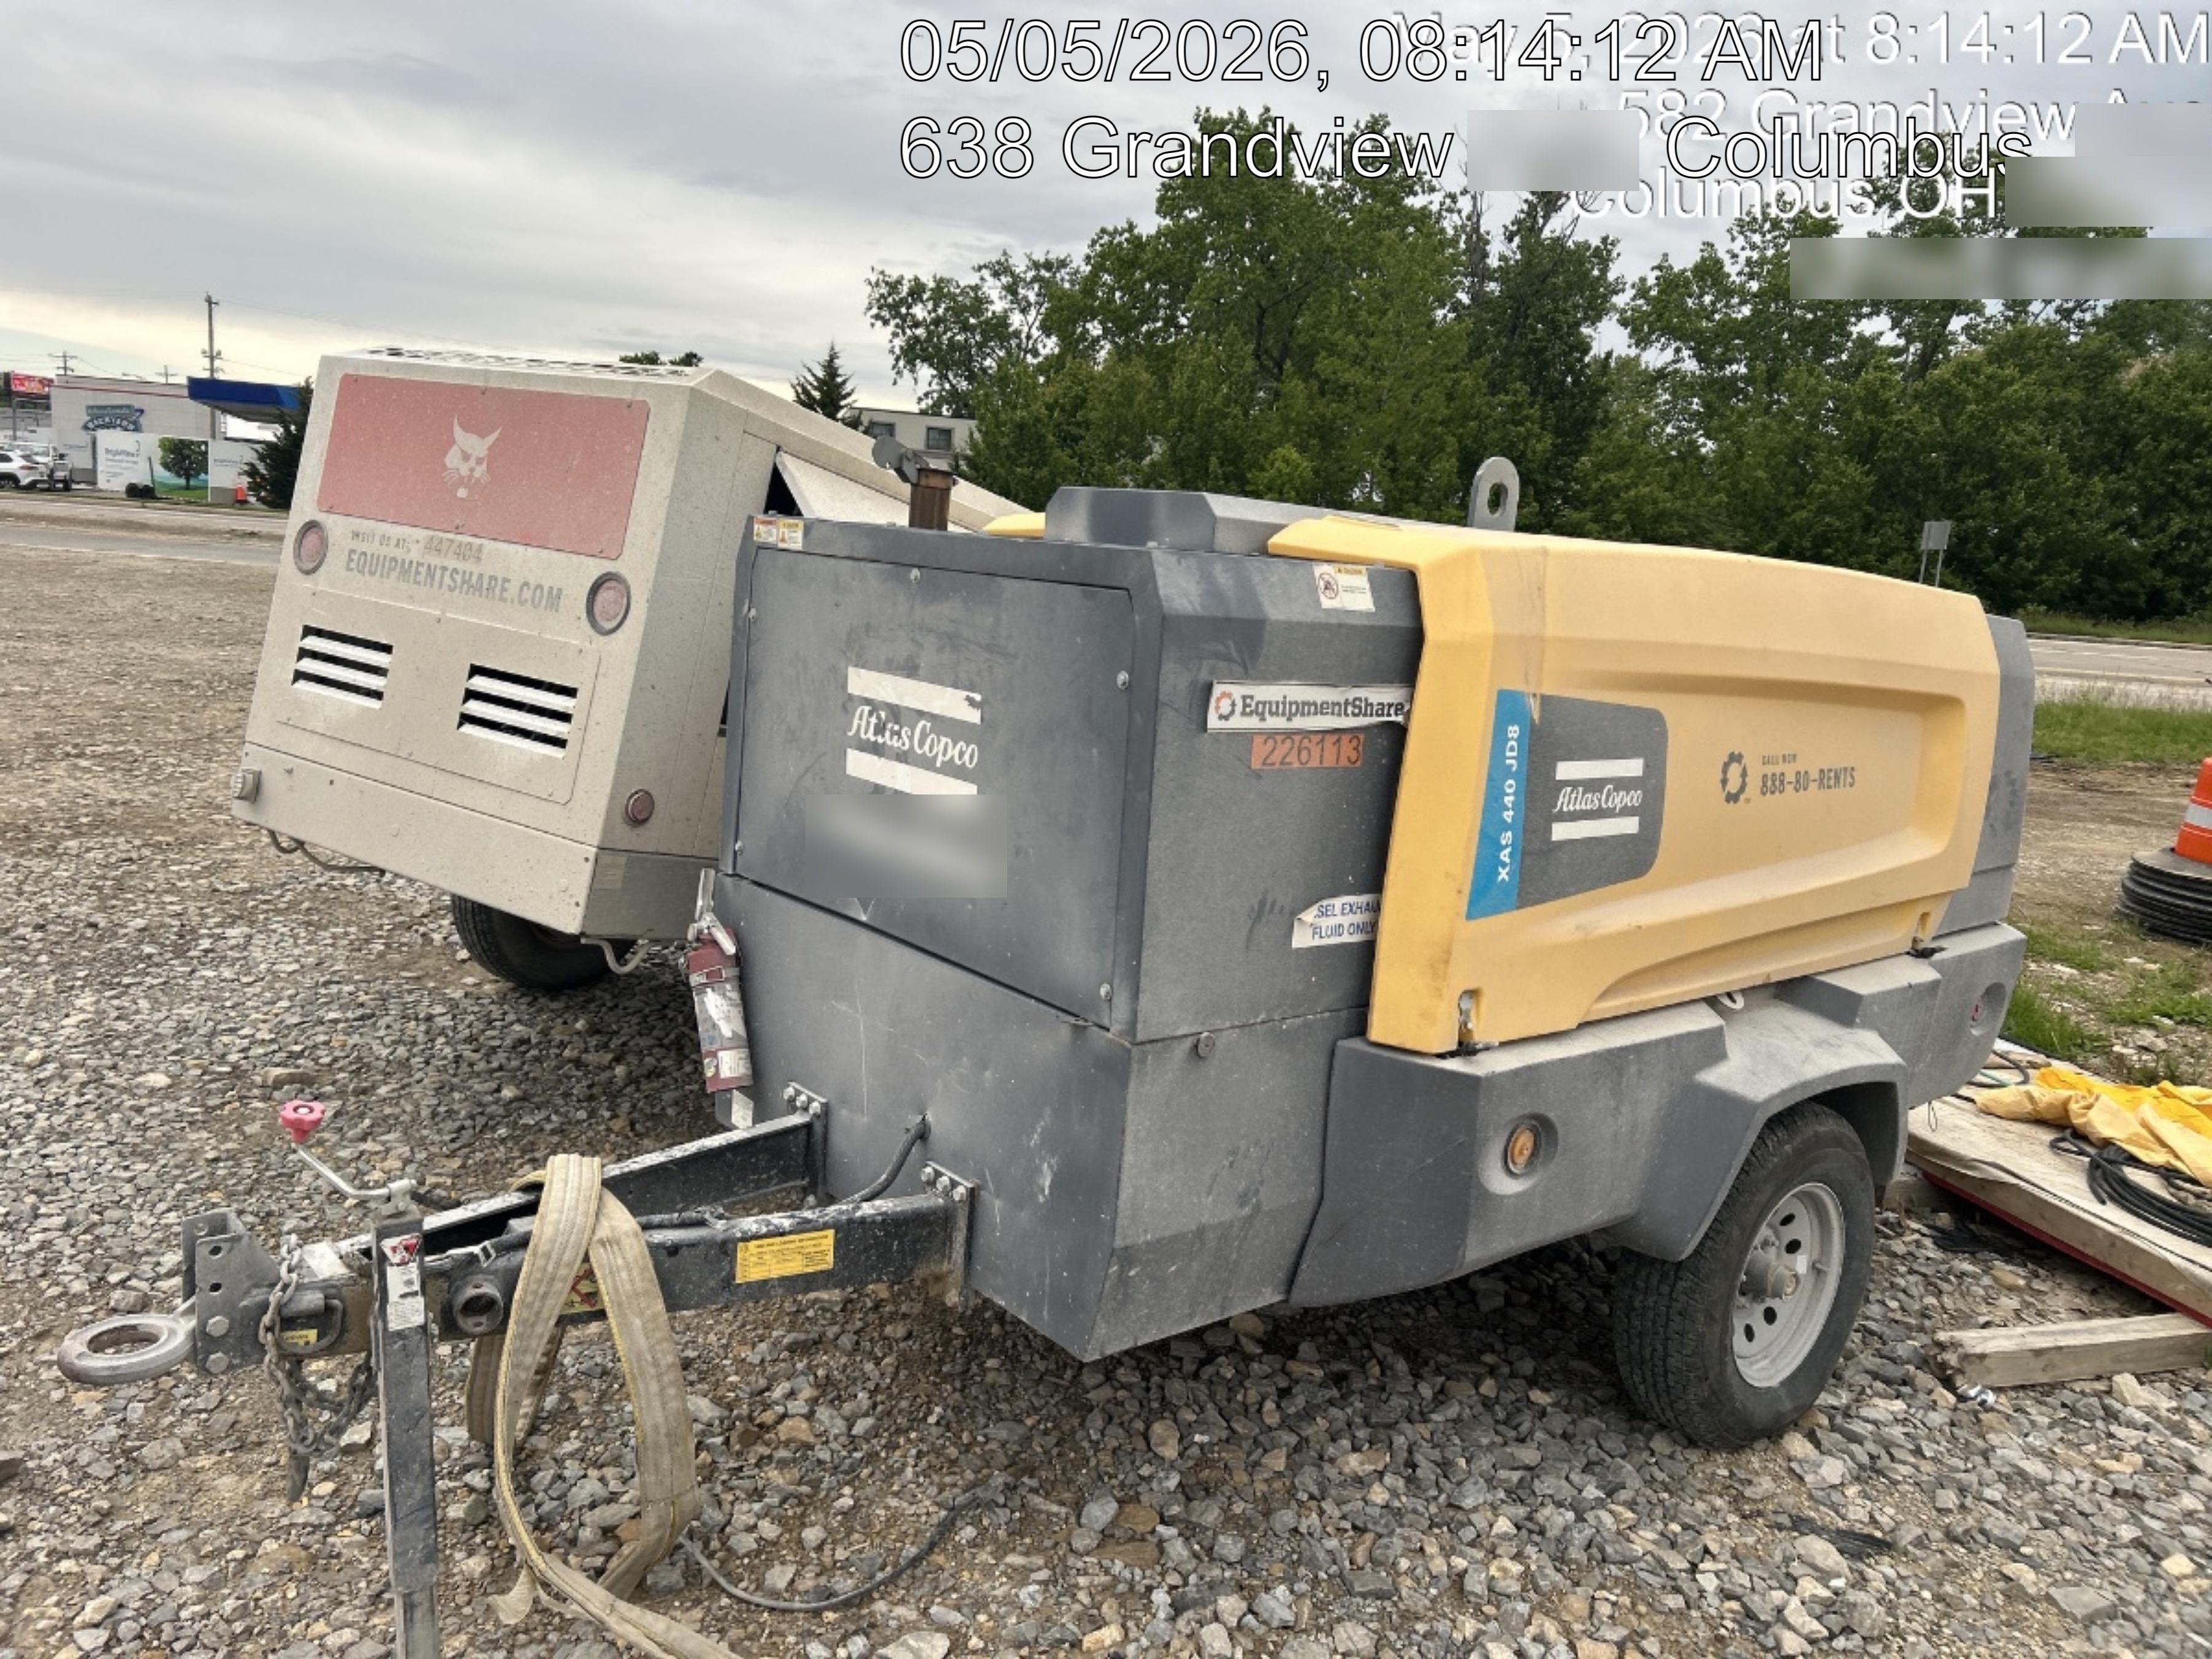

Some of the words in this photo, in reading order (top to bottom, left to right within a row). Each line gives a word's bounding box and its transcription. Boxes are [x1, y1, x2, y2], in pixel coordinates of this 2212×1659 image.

[345, 548, 563, 613] EQUIPMENTSHARE.COM
[1240, 694, 1405, 721] EquipmentShare
[914, 720, 978, 768] Copco
[1261, 736, 1362, 766] 226113
[1505, 724, 1520, 772] JD8
[1760, 766, 1856, 796] 888-80-RENTS
[1502, 779, 1516, 823] 440
[1552, 786, 1601, 814] Atlas
[1601, 784, 1643, 812] Copco
[1497, 831, 1513, 882] XAS
[1341, 899, 1381, 916] EXHAU
[1312, 923, 1344, 940] FLUID
[1347, 921, 1376, 935] ONLY
